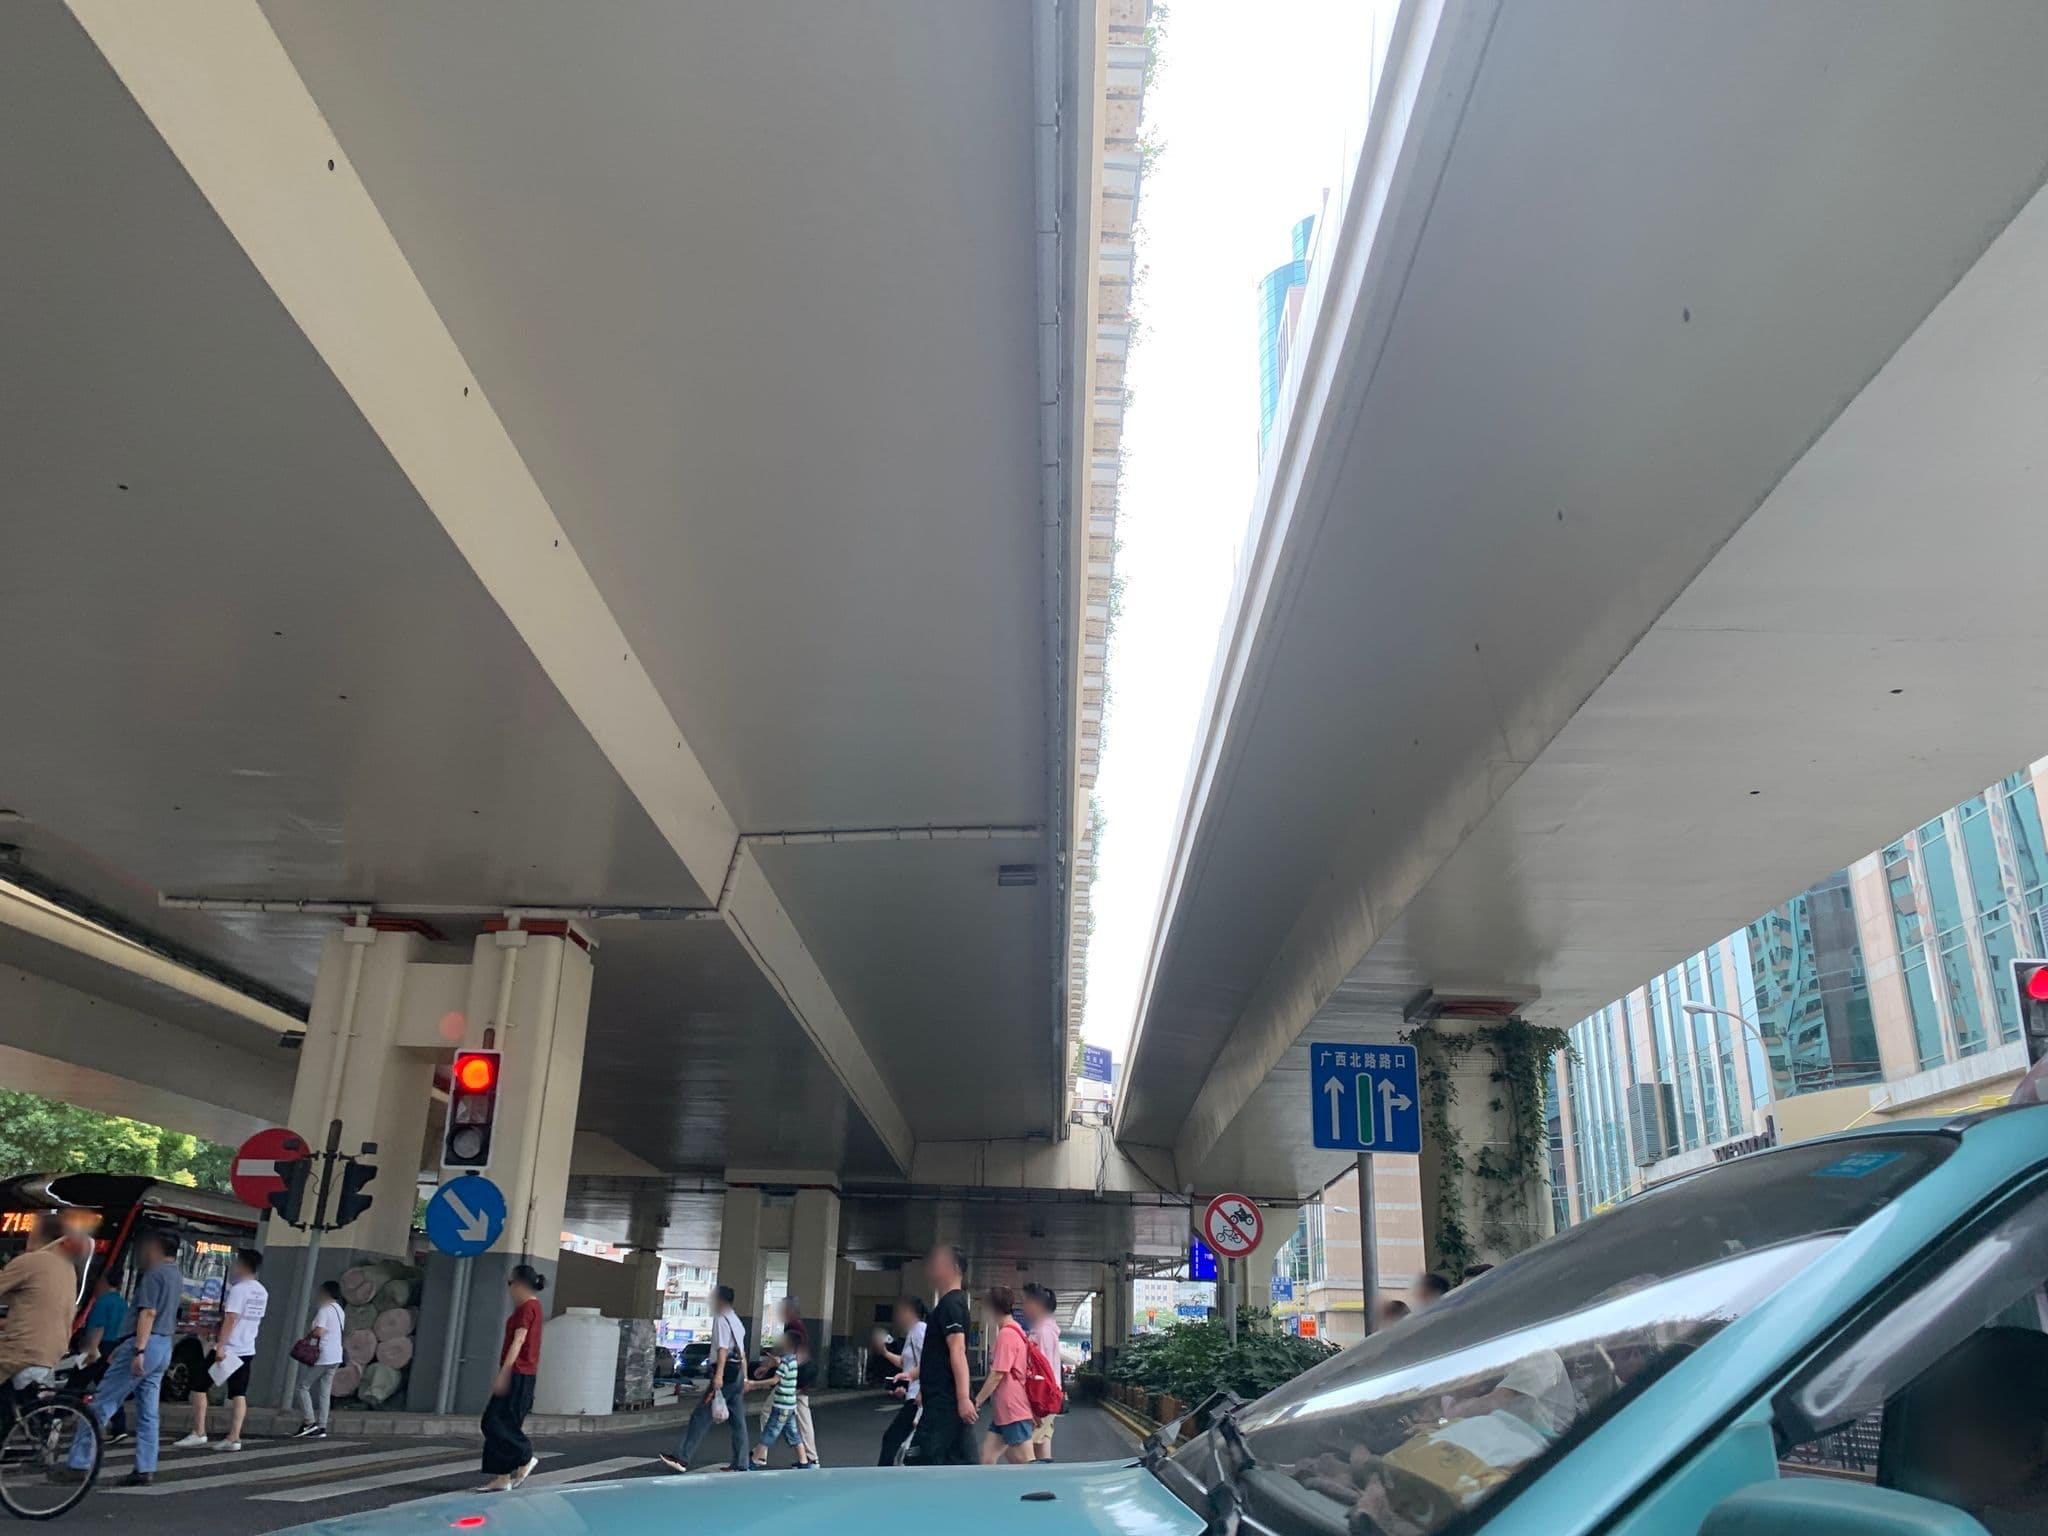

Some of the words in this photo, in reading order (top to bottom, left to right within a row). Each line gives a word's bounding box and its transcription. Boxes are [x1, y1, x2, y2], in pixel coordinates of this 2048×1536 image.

[1320, 1050, 1406, 1069] 广西北路路口
